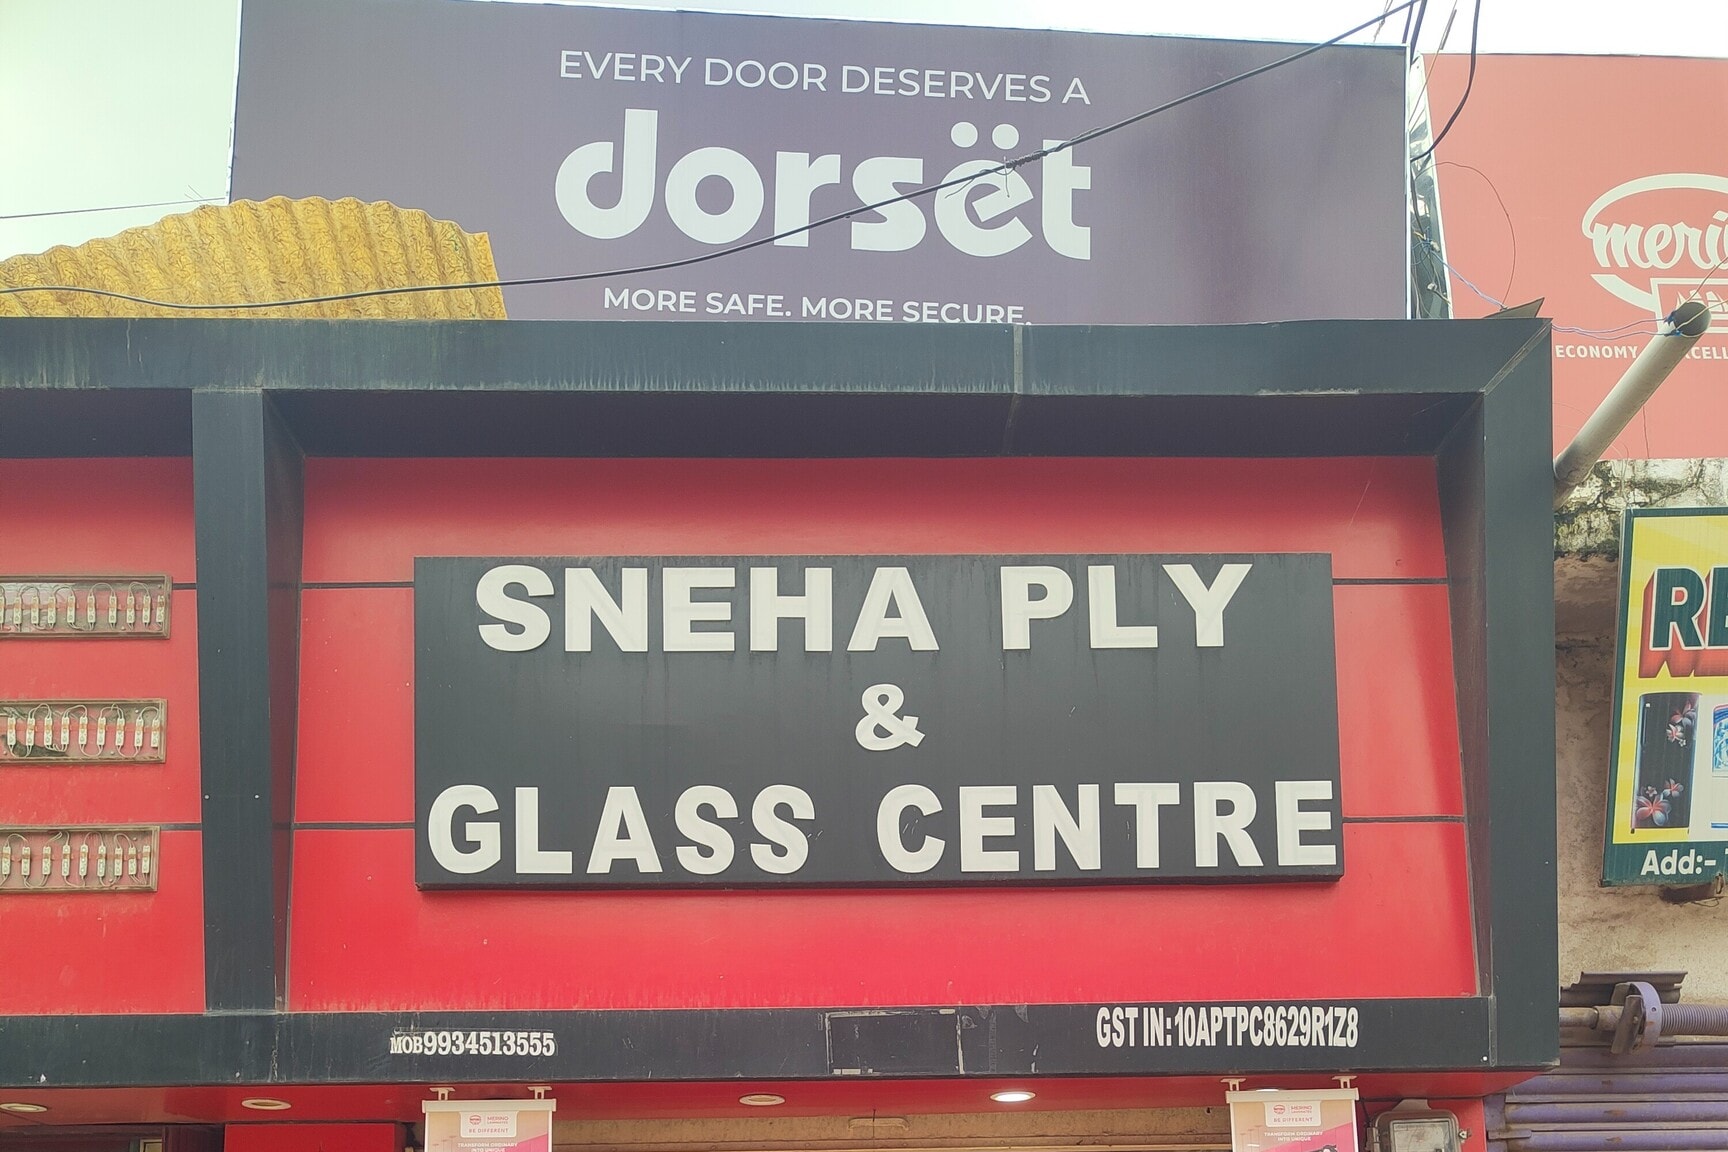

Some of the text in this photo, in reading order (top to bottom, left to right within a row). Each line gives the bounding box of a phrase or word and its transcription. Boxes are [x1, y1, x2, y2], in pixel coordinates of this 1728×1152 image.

[560, 49, 1091, 105] EVERY DOOR DESERVES A
[1590, 210, 1728, 270] meri
[603, 287, 697, 314] MORE
[705, 292, 792, 318] SAFE.
[801, 297, 894, 322] MORE
[1555, 345, 1639, 360] ECONOMY
[476, 563, 1253, 652] SNEHA PLY
[855, 684, 925, 751] &
[428, 780, 1338, 876] GLASS CENTRE
[1640, 848, 1717, 876] Add:-
[1096, 1006, 1139, 1048] GST
